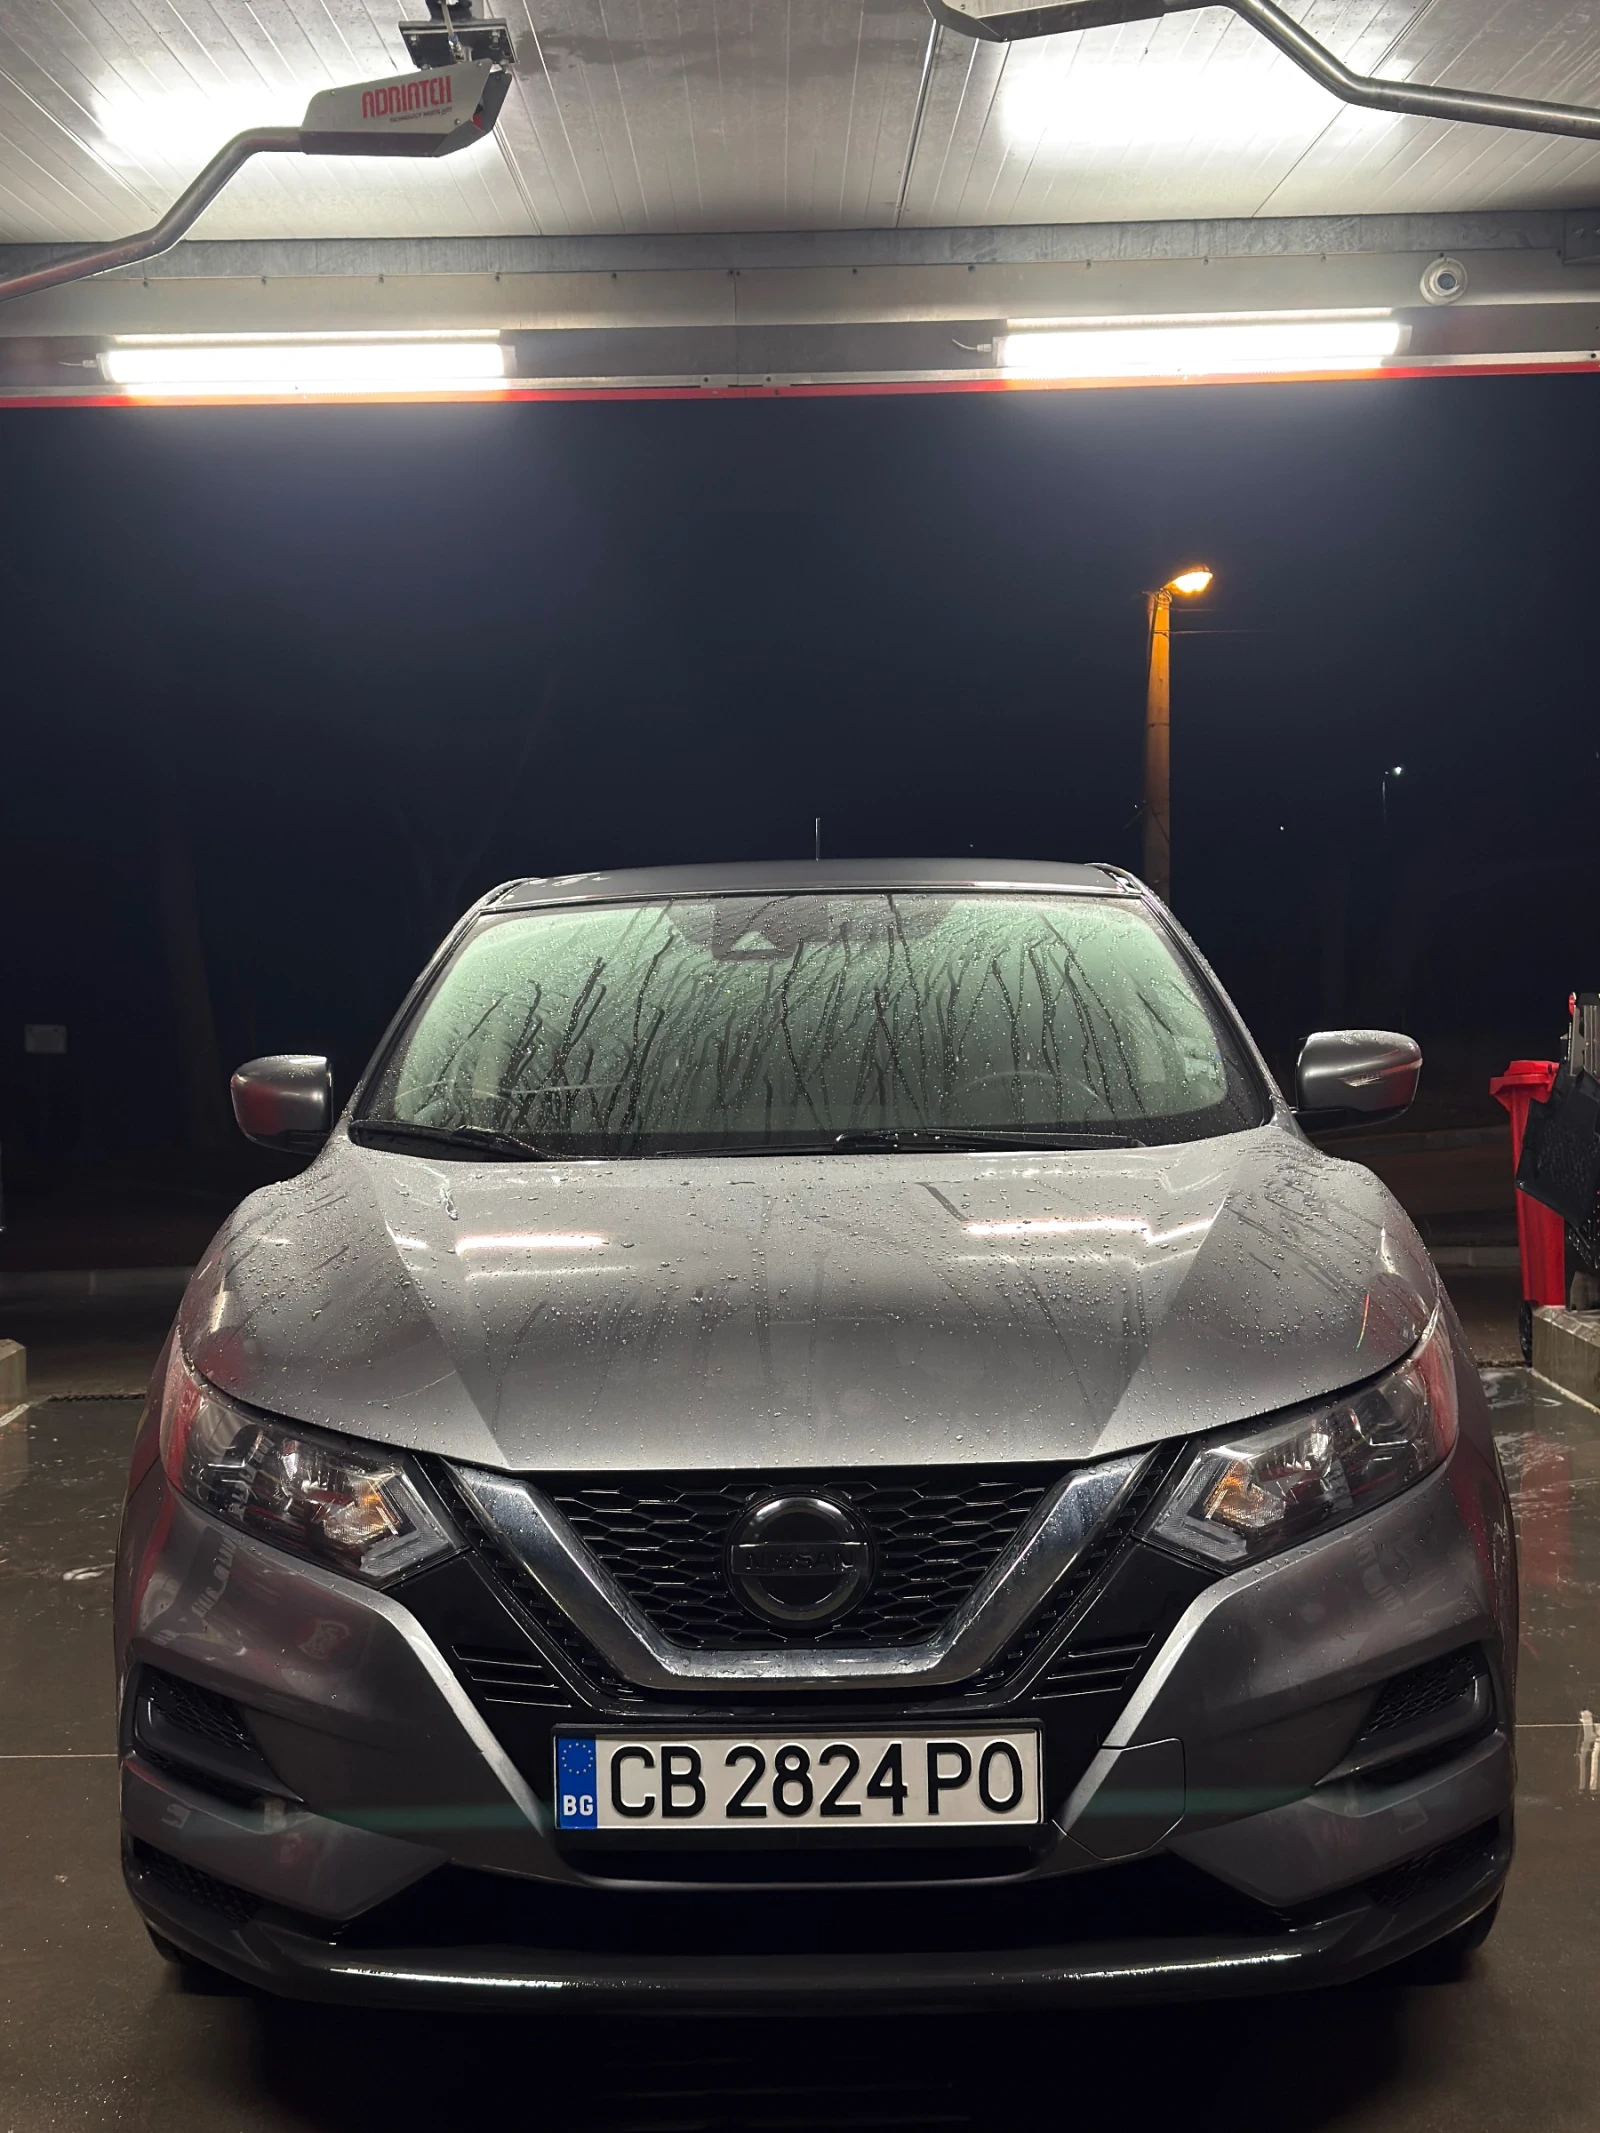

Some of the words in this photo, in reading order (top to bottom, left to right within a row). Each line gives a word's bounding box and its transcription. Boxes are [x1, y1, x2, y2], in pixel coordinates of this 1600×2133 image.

[611, 1745, 706, 1819] CB
[725, 1743, 908, 1819] 2824
[926, 1740, 1023, 1816] PO
[563, 1794, 594, 1816] BG
